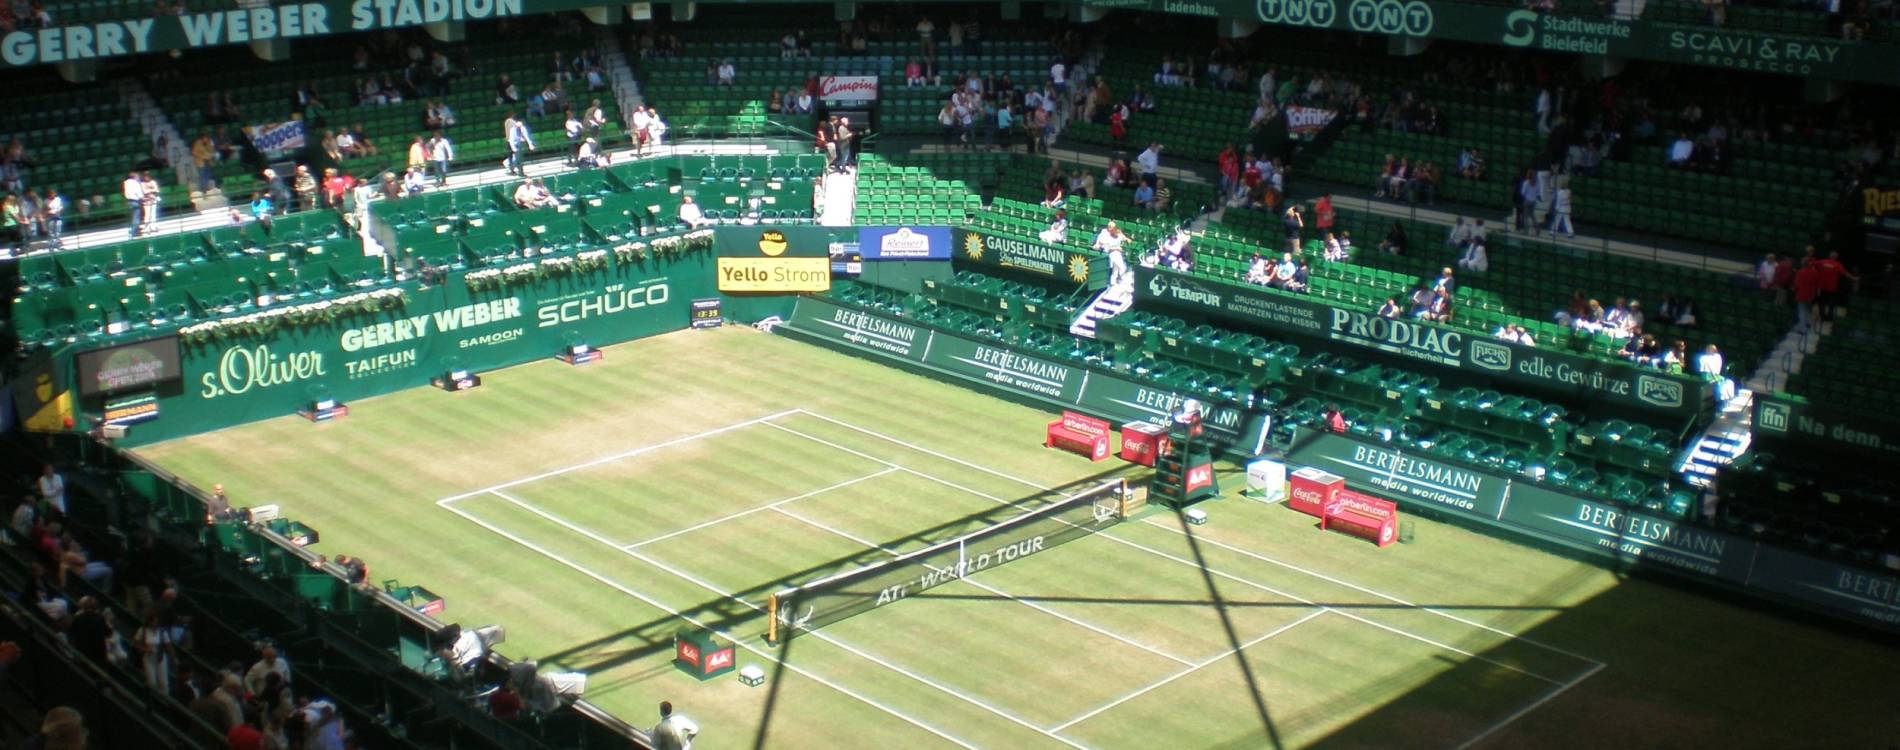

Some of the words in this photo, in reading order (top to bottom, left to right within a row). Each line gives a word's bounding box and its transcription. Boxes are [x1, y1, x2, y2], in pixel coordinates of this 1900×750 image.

[1260, 0, 1334, 26] TNT
[1352, 2, 1430, 35] TNT
[1543, 15, 1631, 38] Stadtwerke
[1, 18, 154, 65] GERRY
[179, 3, 330, 47] WEBER
[351, 0, 522, 30] STADION
[1543, 35, 1608, 56] Bielefeld
[1670, 31, 1753, 55] SCAVI
[1758, 39, 1779, 60] &
[1785, 43, 1840, 64] RAY
[1694, 55, 1812, 75] PROSECCO
[986, 235, 1065, 265] GAUSELMANN
[722, 267, 769, 283] Yello
[773, 266, 827, 283] Strom
[537, 283, 669, 328] SCHÜCO
[1170, 285, 1222, 308] TEMPUR
[1234, 295, 1314, 319] DRUCKENTLASTENDE
[340, 314, 430, 353] GERRY
[433, 296, 521, 333] WEBER
[834, 308, 917, 342] BERTELSMANN
[1228, 304, 1272, 320] MATRATZEN
[1273, 312, 1291, 324] UND
[1292, 314, 1322, 330] KISSEN
[458, 327, 523, 349] SAMOON
[1331, 307, 1462, 358] PRODIAC
[869, 339, 909, 356] worldwide
[1475, 345, 1507, 363] FUCHS
[201, 344, 328, 399] s.Oliver
[345, 348, 416, 375] TAIFUN
[974, 346, 1068, 381] BERTELSMANN
[1015, 379, 1061, 397] worldwide
[1519, 357, 1554, 379] edle
[1557, 364, 1630, 396] Gewürze
[1643, 380, 1679, 400] FUCHS
[1136, 388, 1243, 430] BERTEMANN
[1764, 407, 1785, 427] ffn
[1063, 418, 1105, 437] airberlin.com
[1797, 415, 1825, 436] Na
[1354, 446, 1482, 492] BERTELSMANN
[1370, 476, 1409, 493] media
[1412, 487, 1475, 510] worldwide
[1340, 497, 1391, 519] airberlin.com
[1579, 503, 1727, 556] BERTELSMANN
[1598, 538, 1642, 556] media
[921, 556, 989, 589] WORLD
[995, 536, 1044, 564] TOUR
